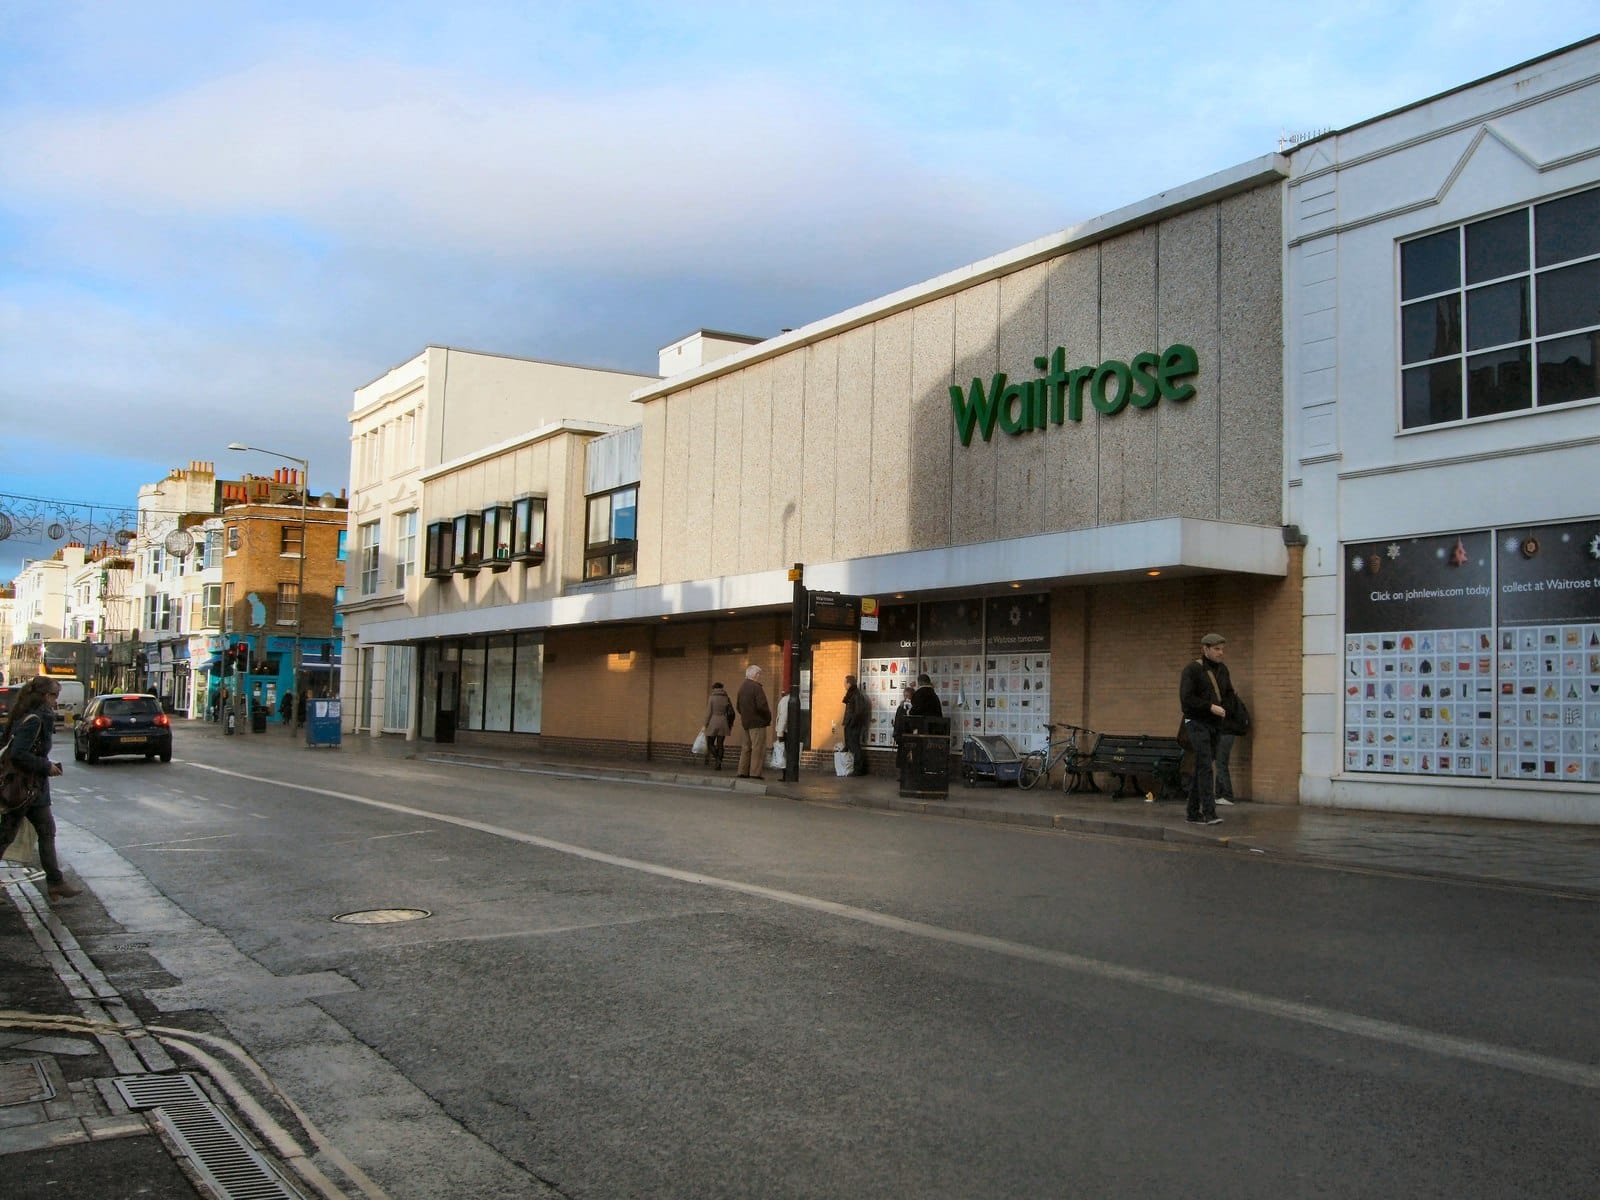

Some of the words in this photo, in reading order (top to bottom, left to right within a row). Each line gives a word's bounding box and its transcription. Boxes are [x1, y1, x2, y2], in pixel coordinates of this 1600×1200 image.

[948, 343, 1199, 447] Waitrose
[1370, 591, 1391, 601] Click
[1392, 592, 1404, 600] on
[1405, 587, 1464, 602] johnlewis.com
[1502, 582, 1533, 593] collect
[1534, 582, 1544, 591] at
[1546, 578, 1591, 590] Waitrose
